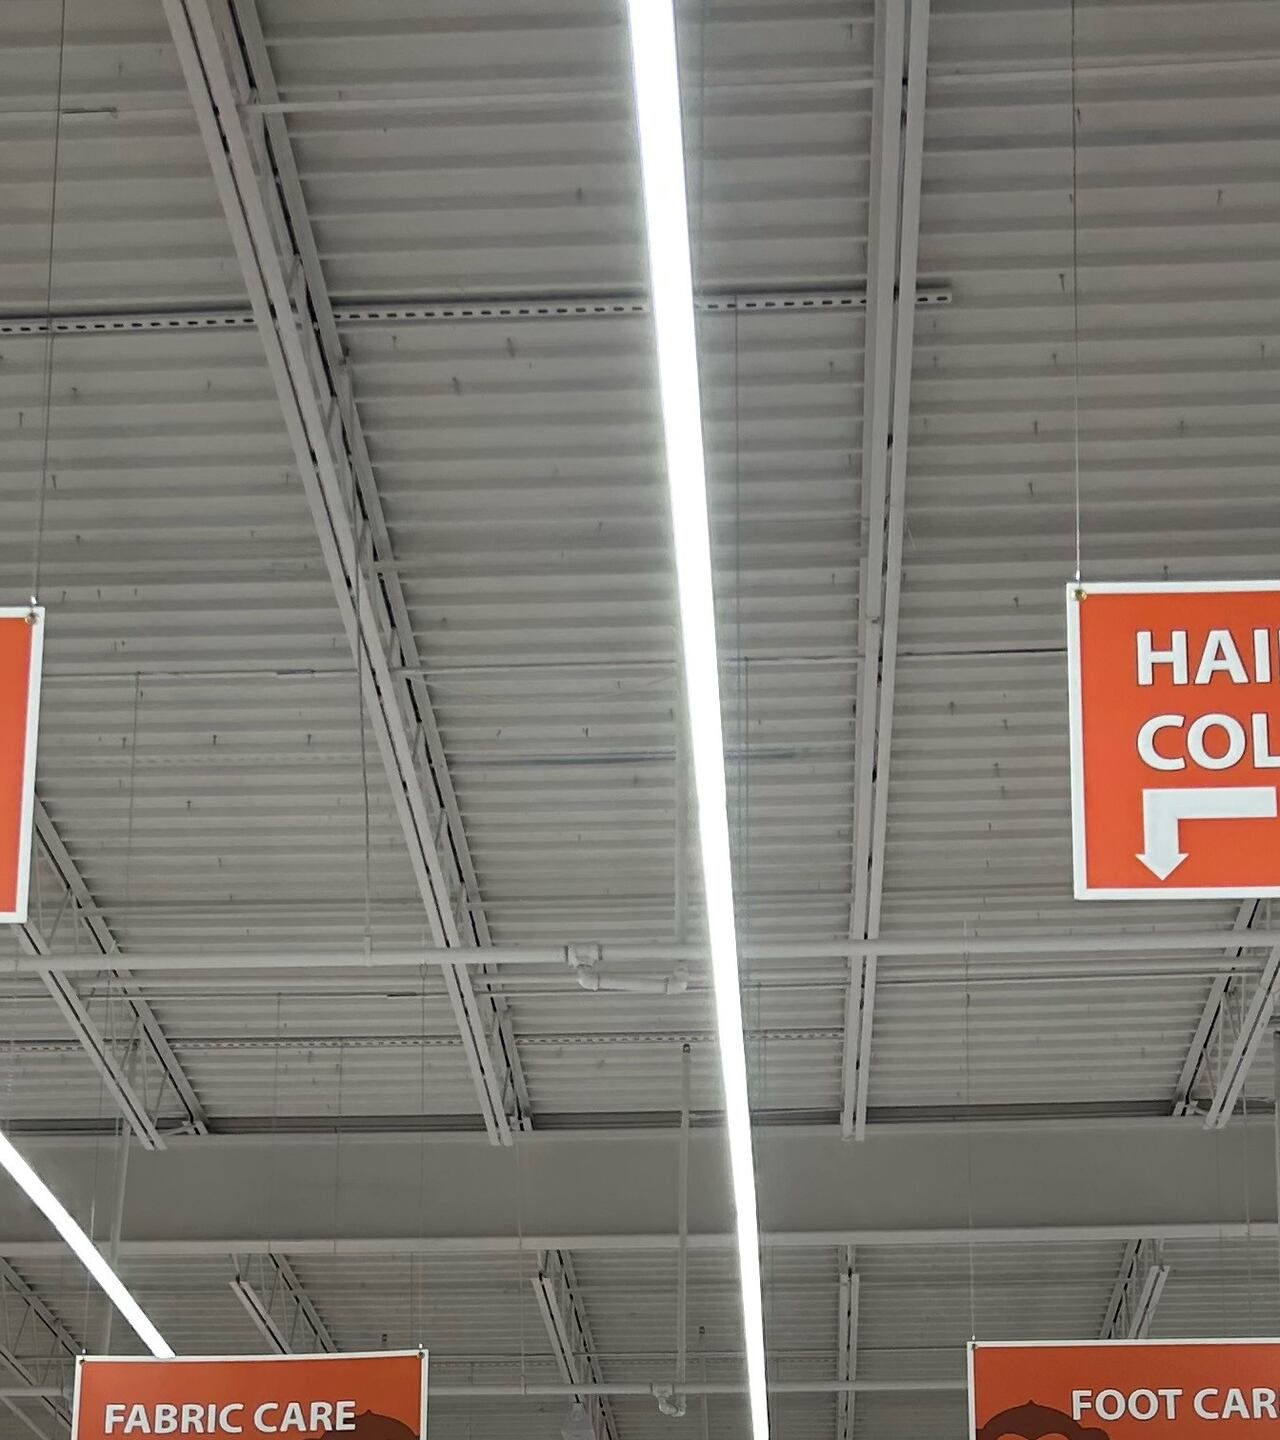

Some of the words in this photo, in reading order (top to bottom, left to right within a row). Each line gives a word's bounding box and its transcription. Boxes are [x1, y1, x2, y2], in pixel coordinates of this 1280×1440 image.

[105, 1403, 244, 1434] FABRIC
[254, 1400, 356, 1432] CARE
[1072, 1388, 1182, 1421] FOOT
